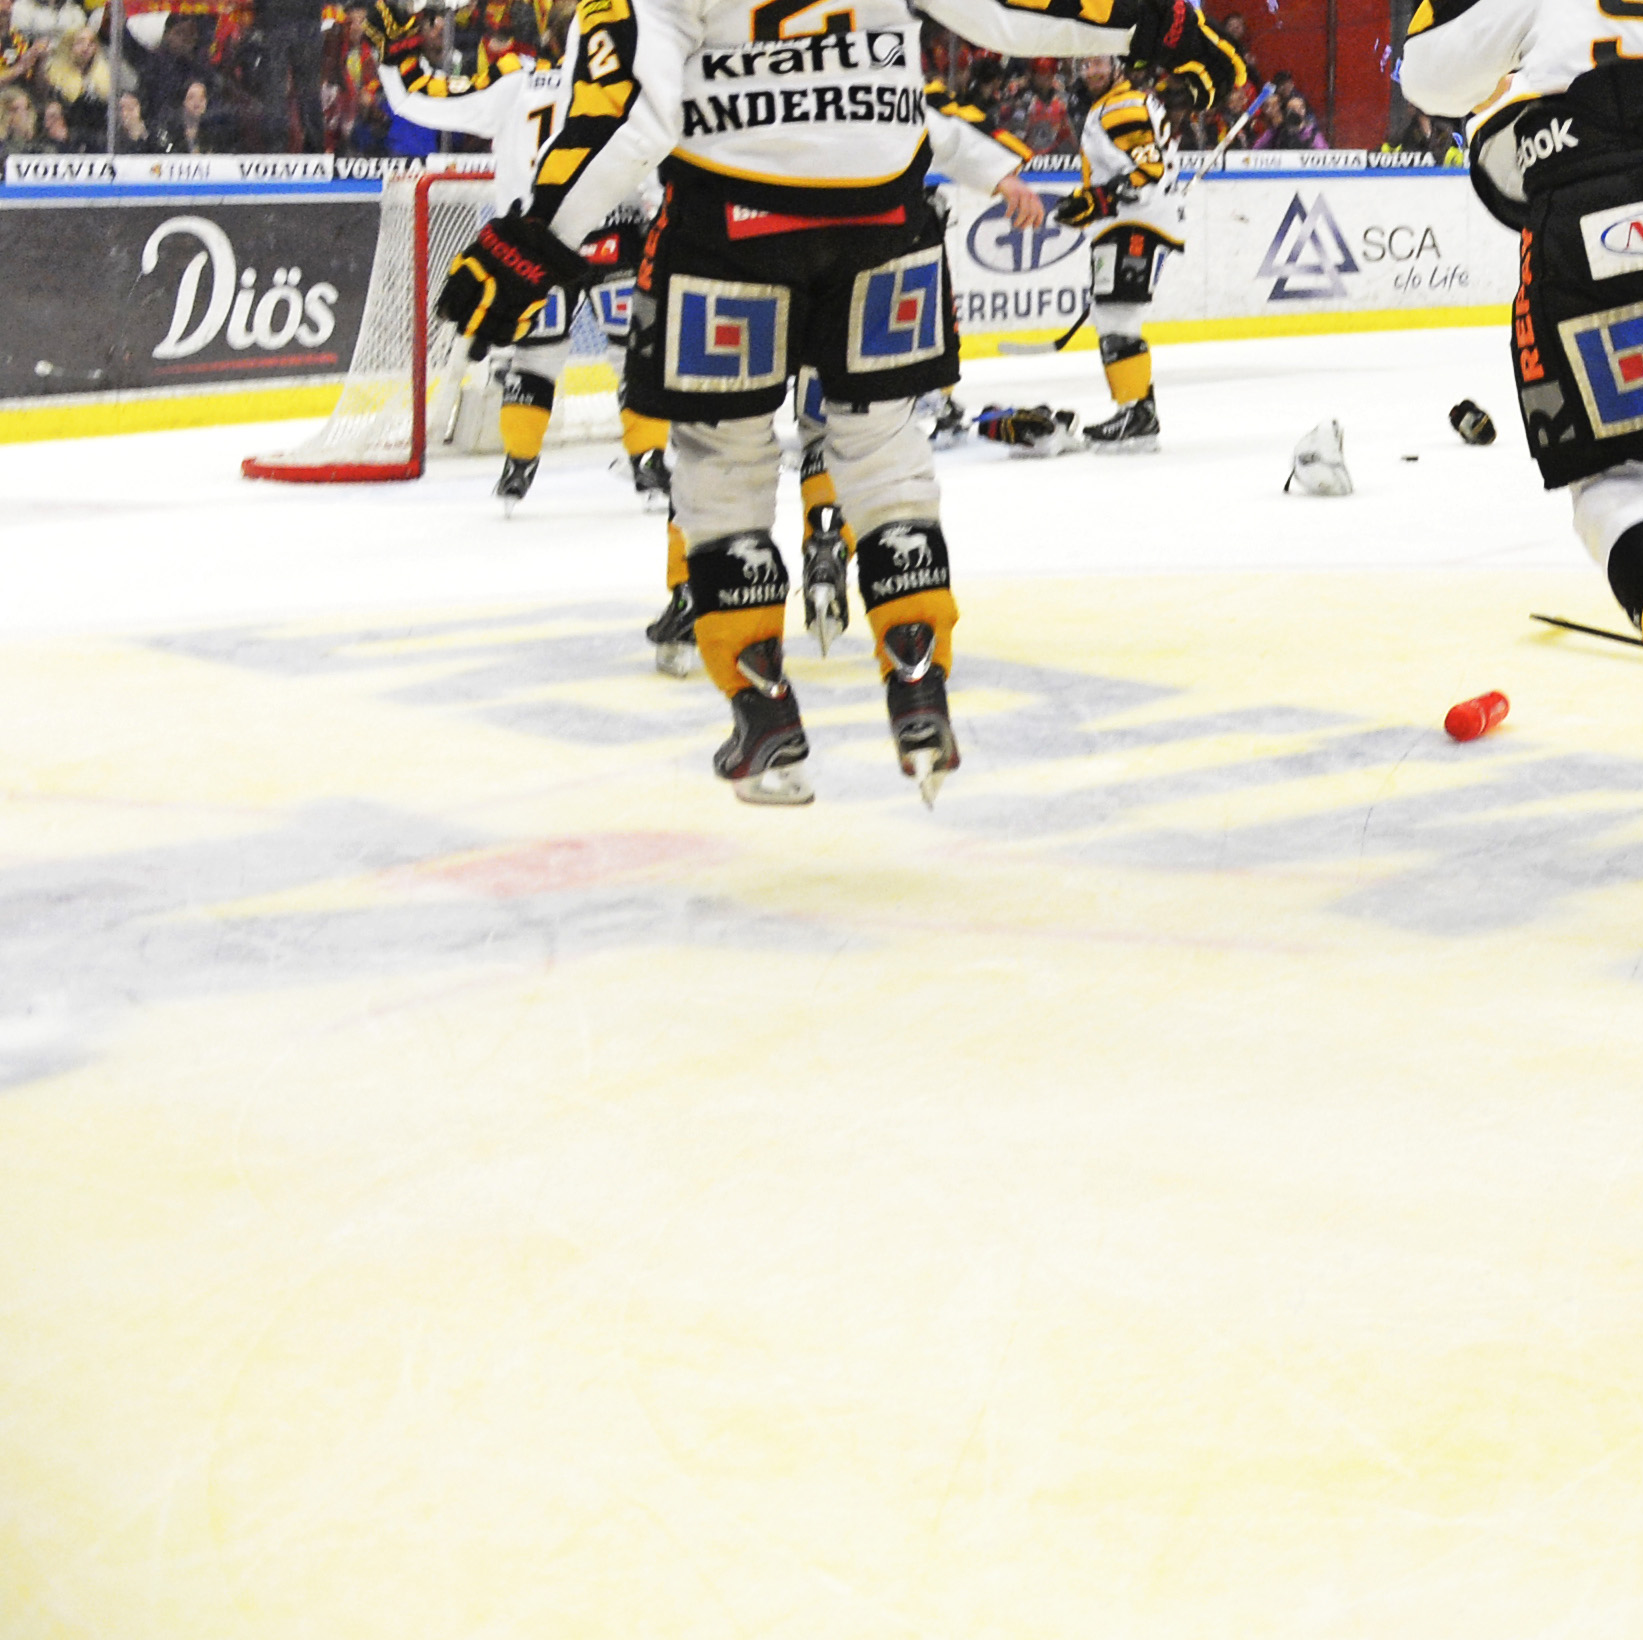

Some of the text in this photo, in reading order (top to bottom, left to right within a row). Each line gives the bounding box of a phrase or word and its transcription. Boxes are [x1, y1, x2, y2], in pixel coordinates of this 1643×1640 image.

[587, 28, 621, 81] 2
[701, 33, 859, 81] kraft
[15, 161, 115, 182] VOLVIA
[239, 160, 327, 180] VOLVIA
[1368, 151, 1437, 168] VOLVIA
[1361, 226, 1443, 263] SCA
[142, 215, 339, 359] Diös
[1427, 262, 1471, 290] Life
[955, 286, 1091, 323] ERRUFO
